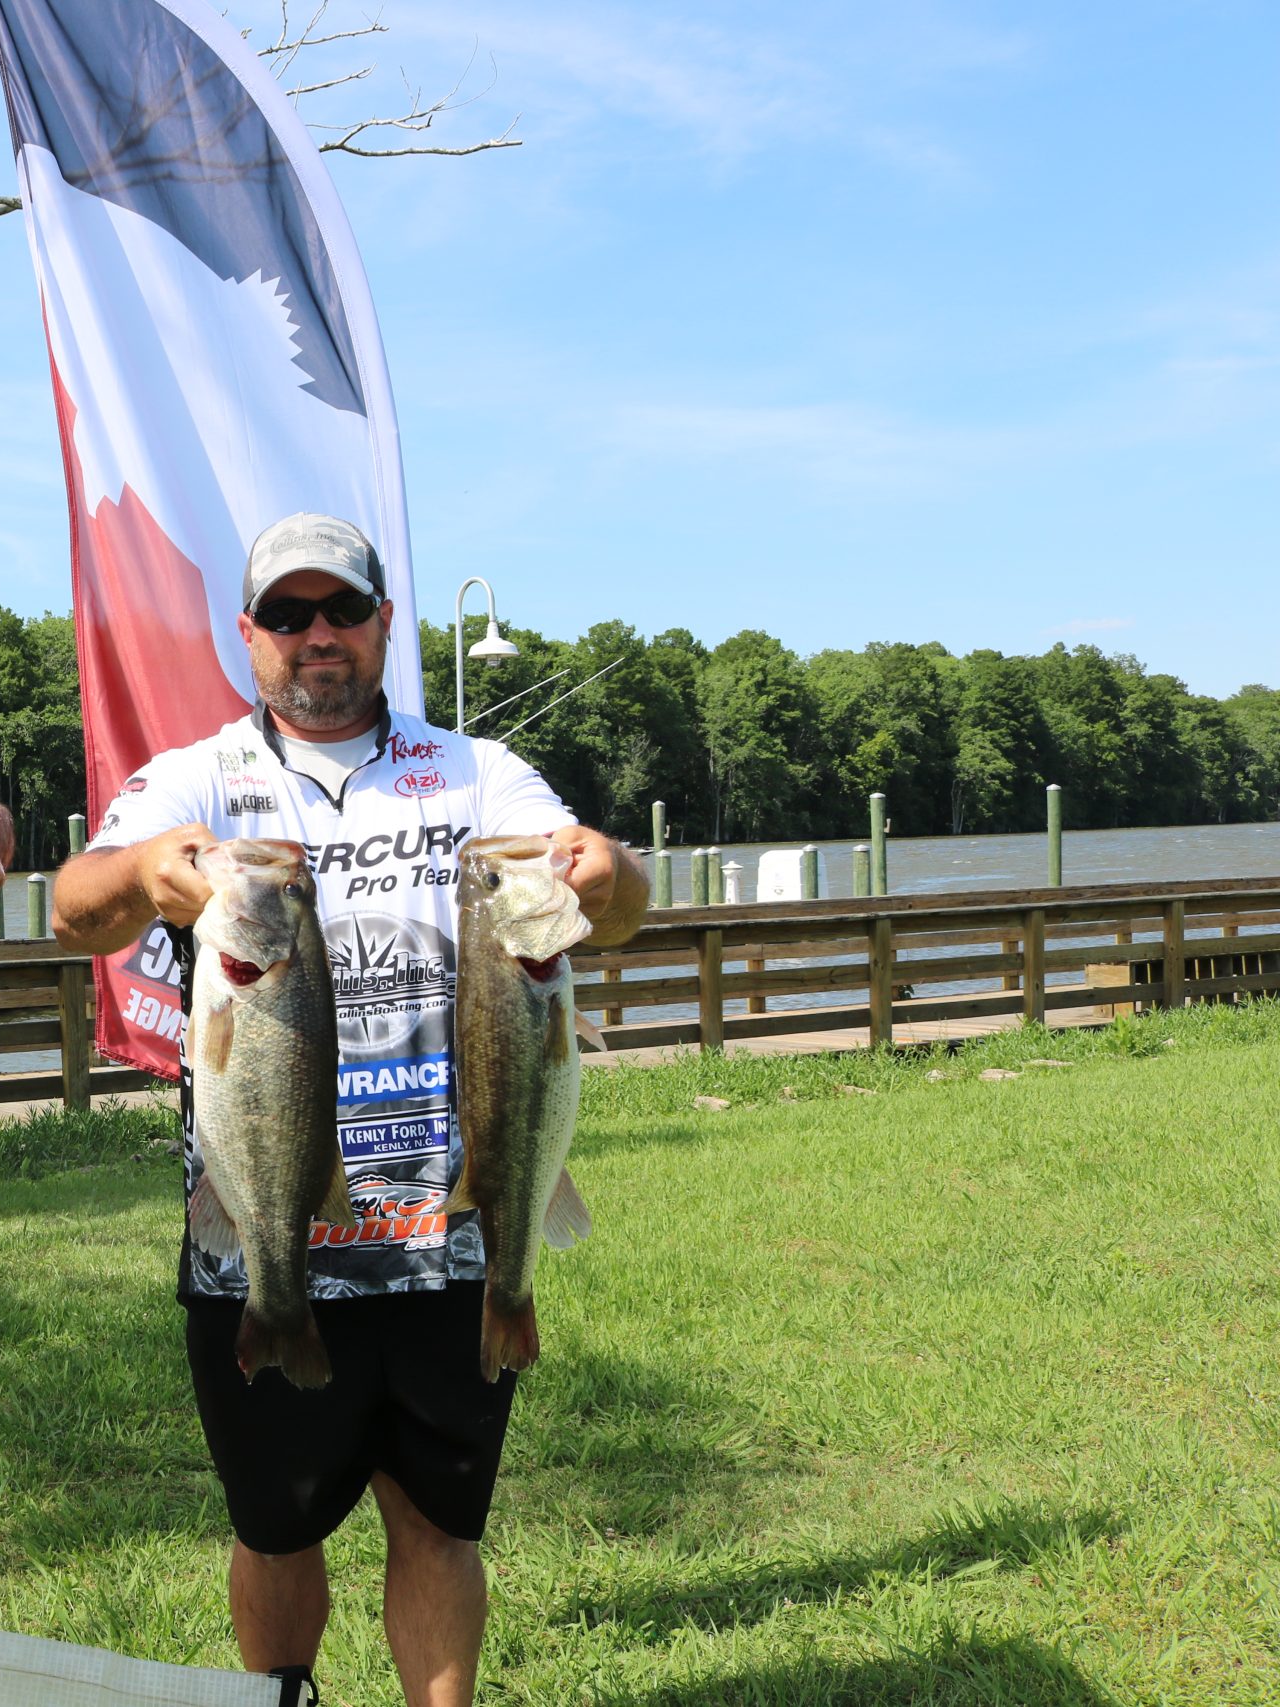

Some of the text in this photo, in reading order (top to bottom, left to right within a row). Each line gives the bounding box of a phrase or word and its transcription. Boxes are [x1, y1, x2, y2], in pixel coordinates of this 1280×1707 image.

[346, 875, 398, 900] Pro
[394, 952, 447, 986] Inc.
[433, 1119, 449, 1135] IN
[373, 1137, 436, 1153] KENLY, N.C.
